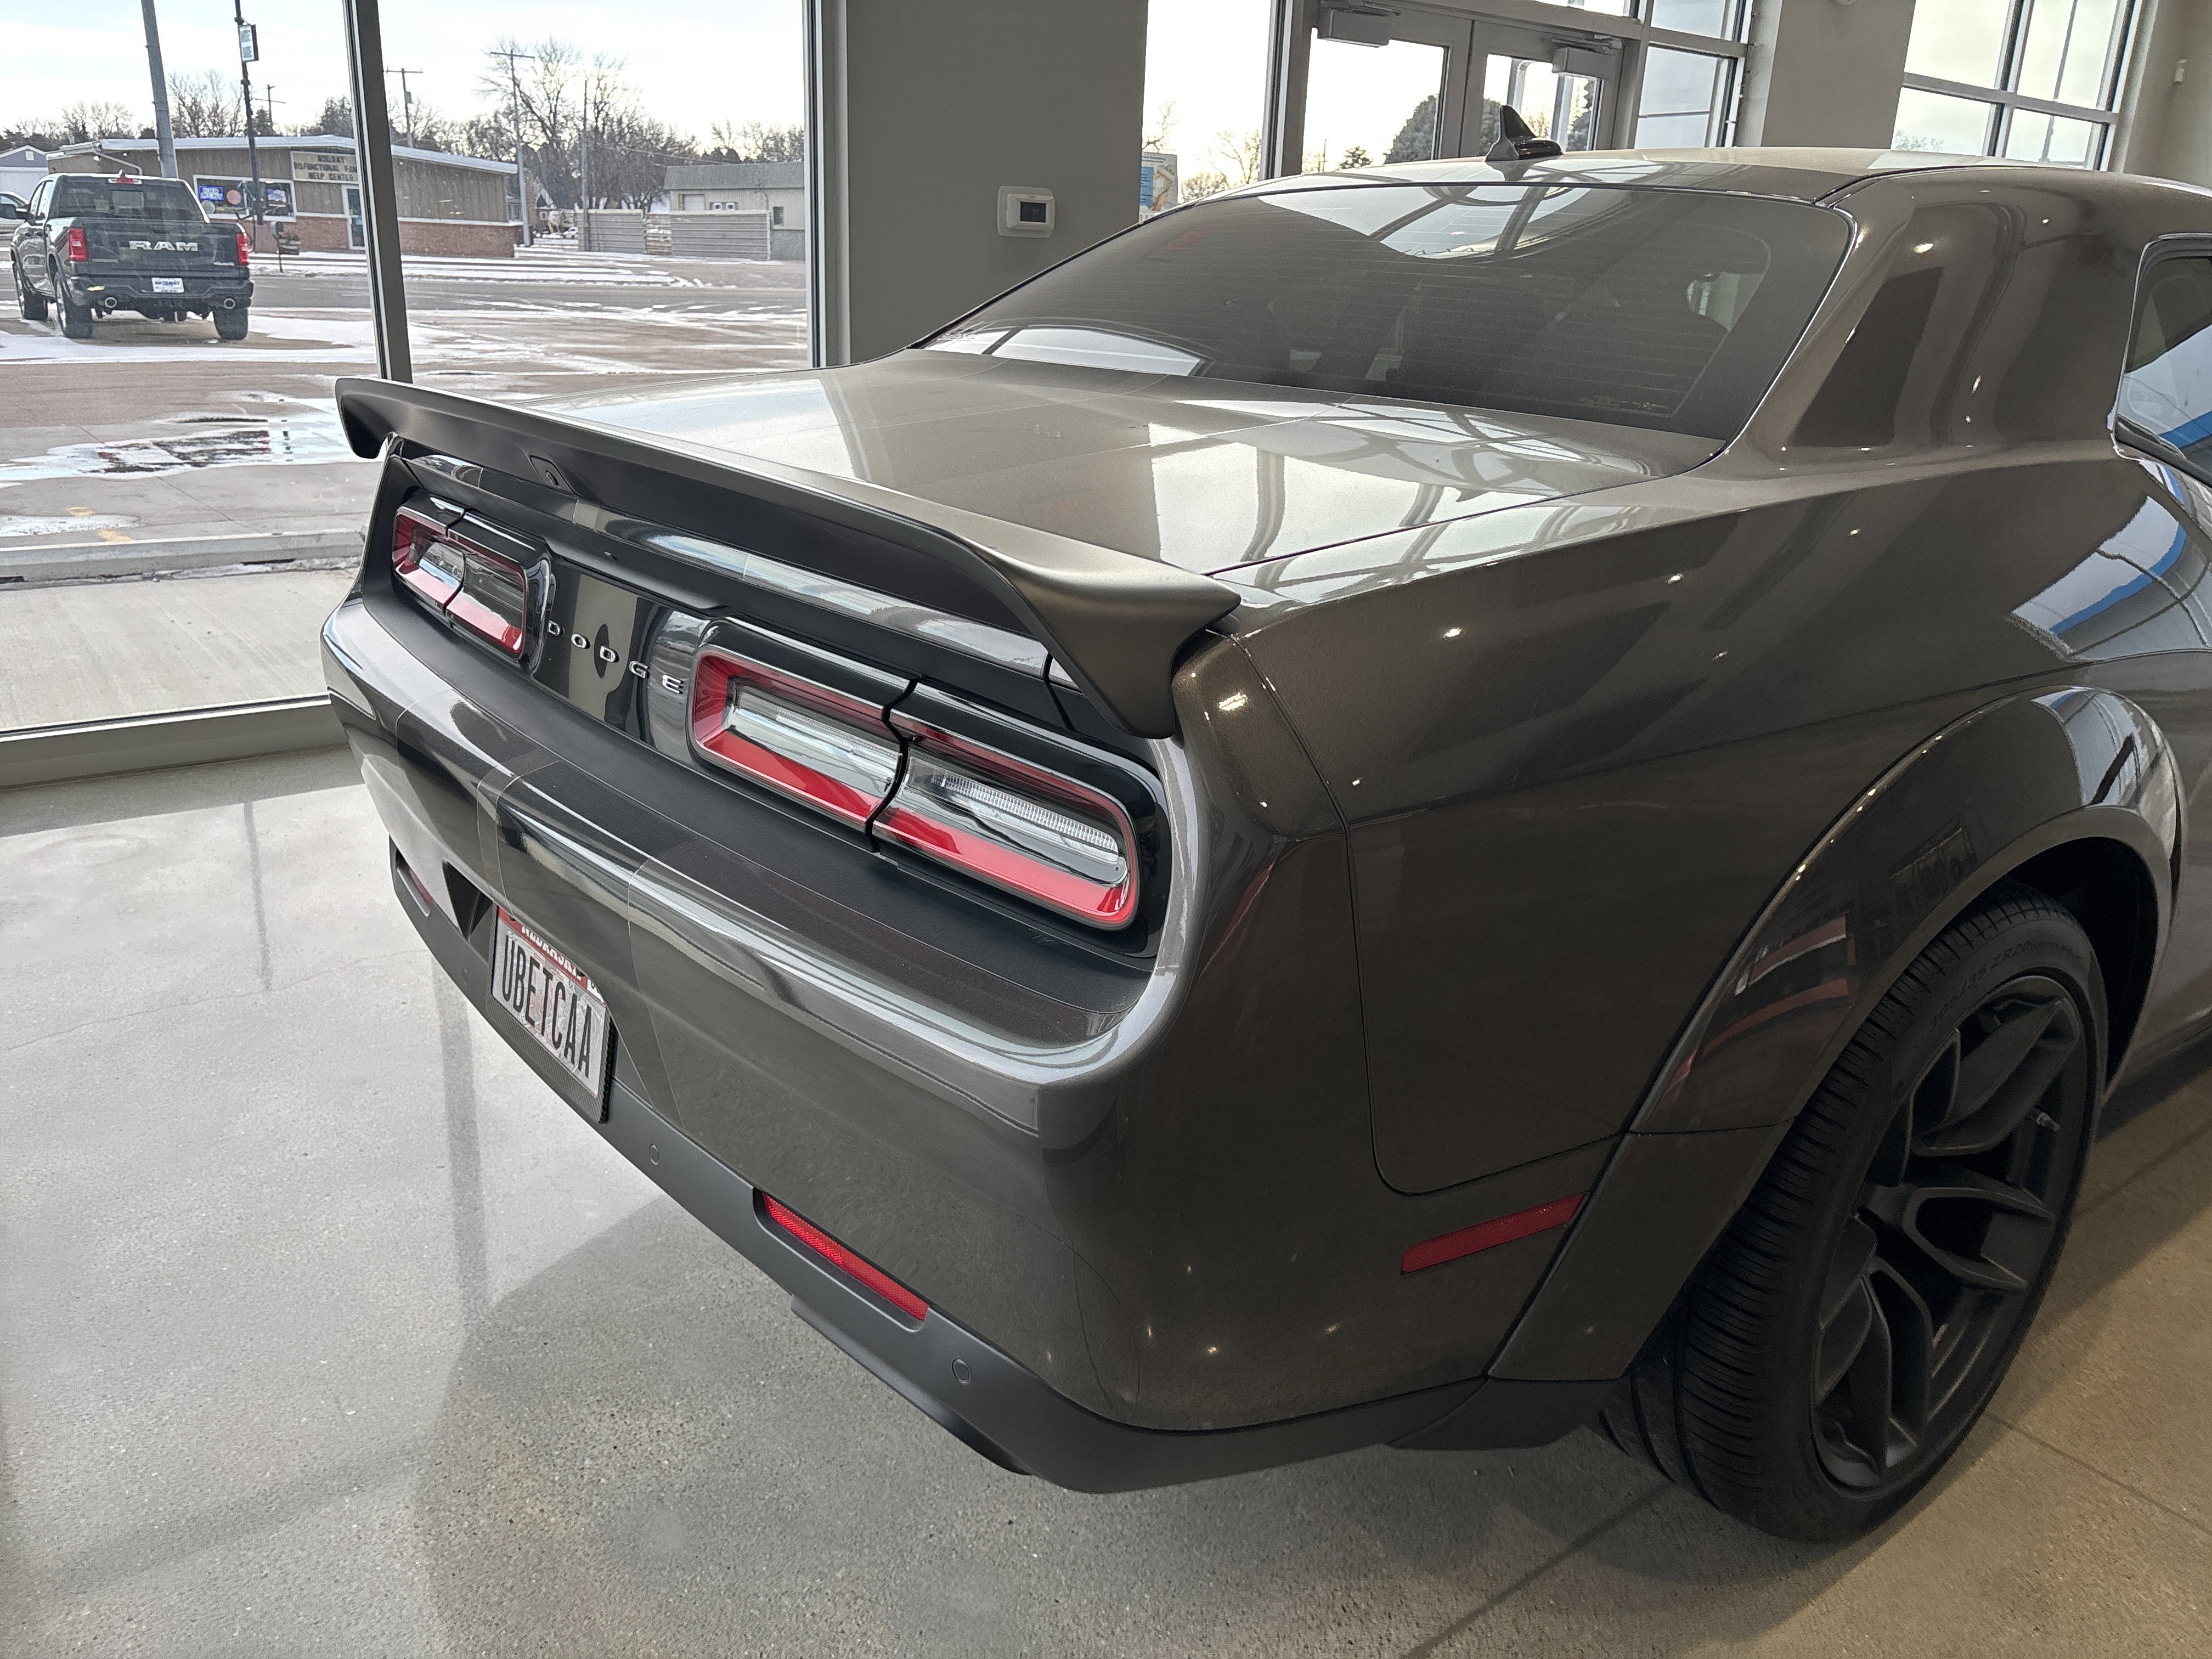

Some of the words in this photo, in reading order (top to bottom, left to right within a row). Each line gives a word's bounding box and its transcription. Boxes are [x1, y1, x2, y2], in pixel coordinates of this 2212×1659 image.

[308, 172, 325, 180] HELP
[329, 173, 354, 182] CENTER
[129, 240, 198, 252] RAM
[549, 620, 684, 694] DODGE
[501, 934, 592, 1079] UBETCAA
